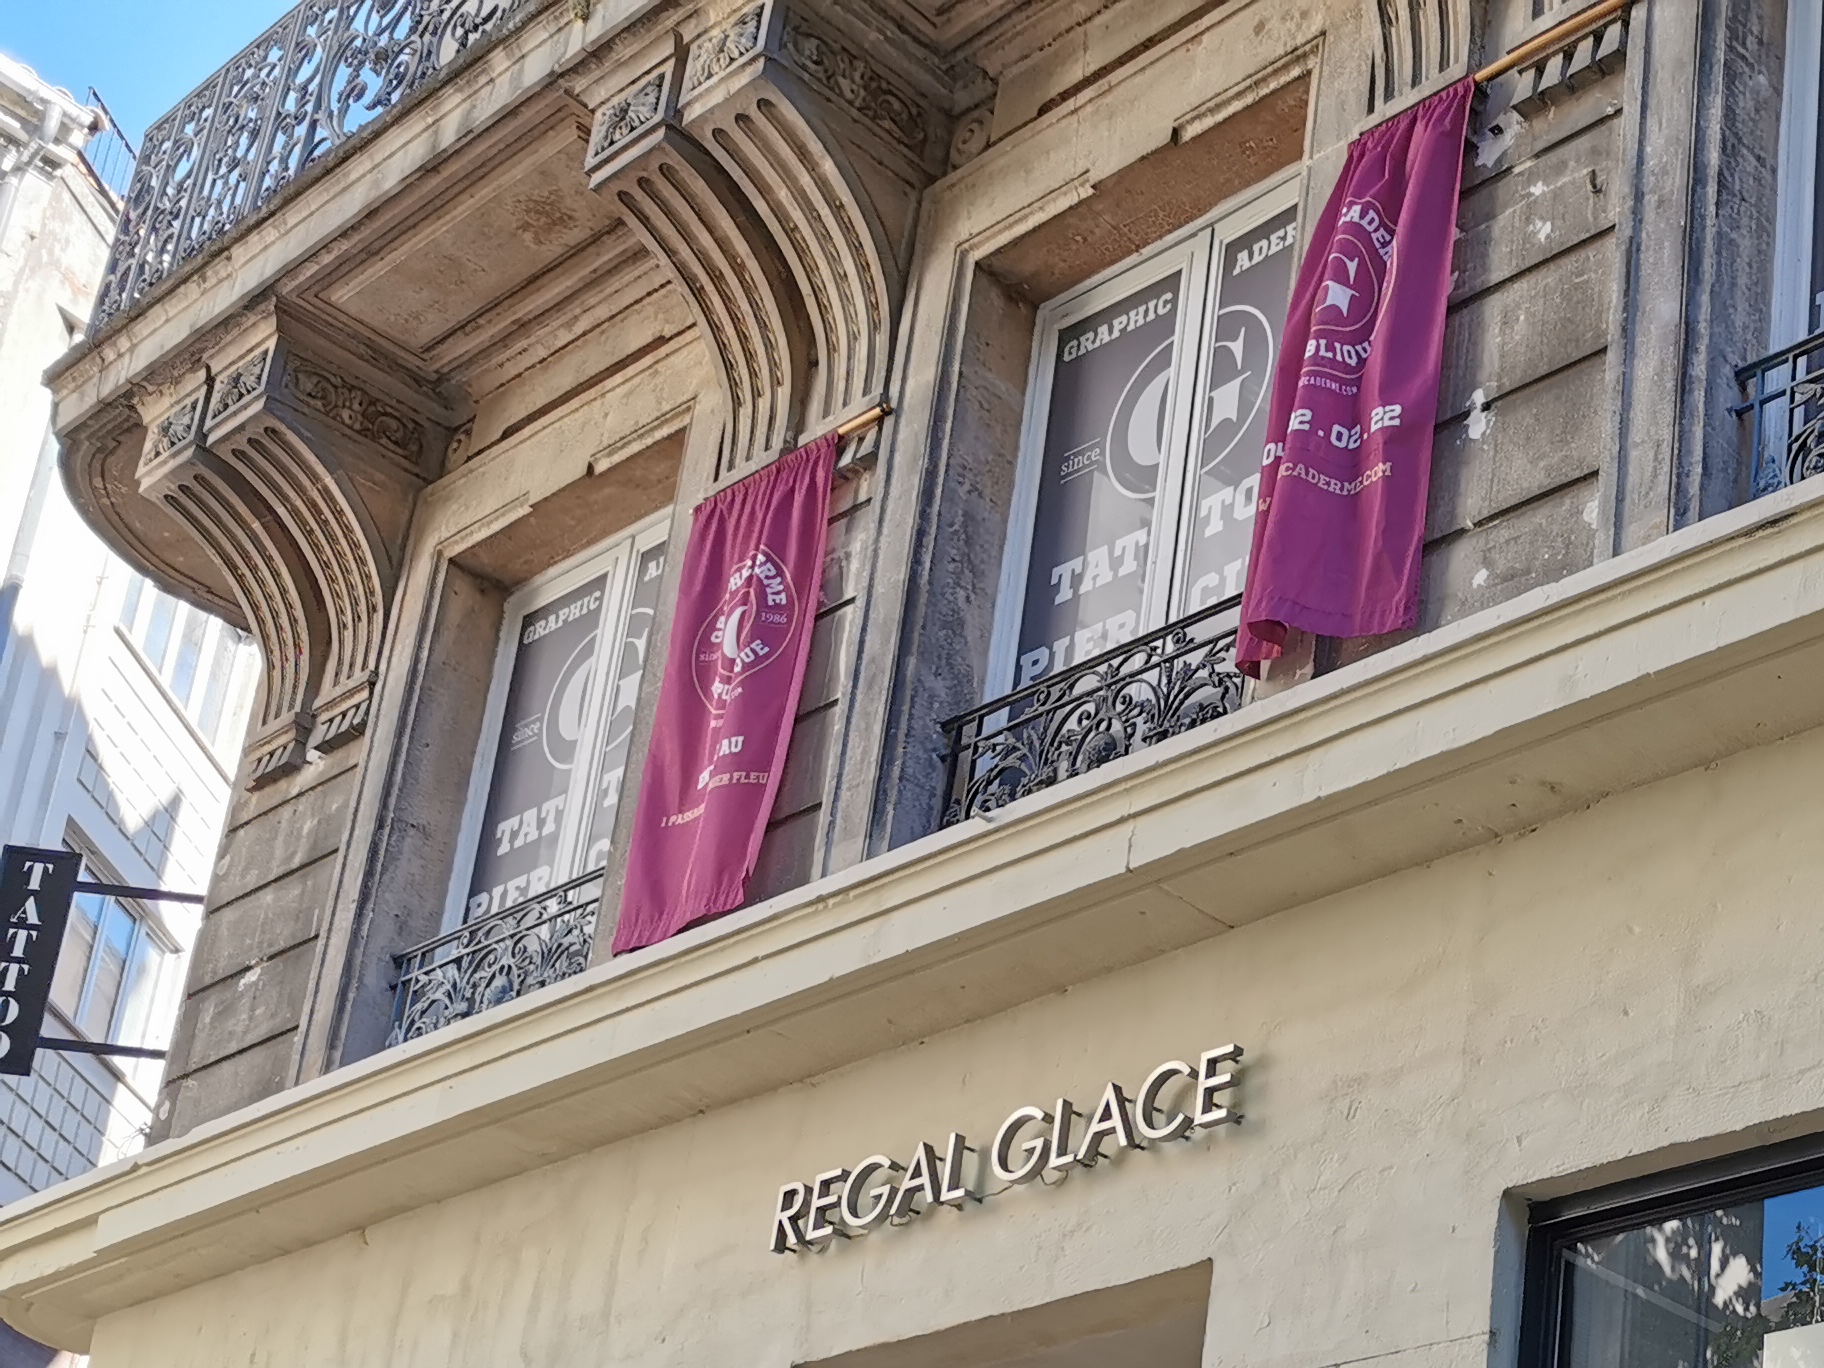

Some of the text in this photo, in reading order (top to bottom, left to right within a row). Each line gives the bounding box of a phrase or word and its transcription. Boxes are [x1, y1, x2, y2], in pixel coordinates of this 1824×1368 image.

[1061, 292, 1173, 362] GRAPHIC
[1060, 447, 1100, 476] since
[1051, 527, 1148, 606] TAT
[1190, 556, 1248, 612] CI
[522, 591, 601, 645] GRAPHIC
[760, 612, 788, 624] 1986
[1017, 610, 1138, 690] PIER
[511, 721, 541, 744] since
[716, 736, 744, 757] AU
[497, 794, 566, 857] TAT
[466, 865, 551, 924] PIER
[770, 1043, 1244, 1253] REGAL GLACE
